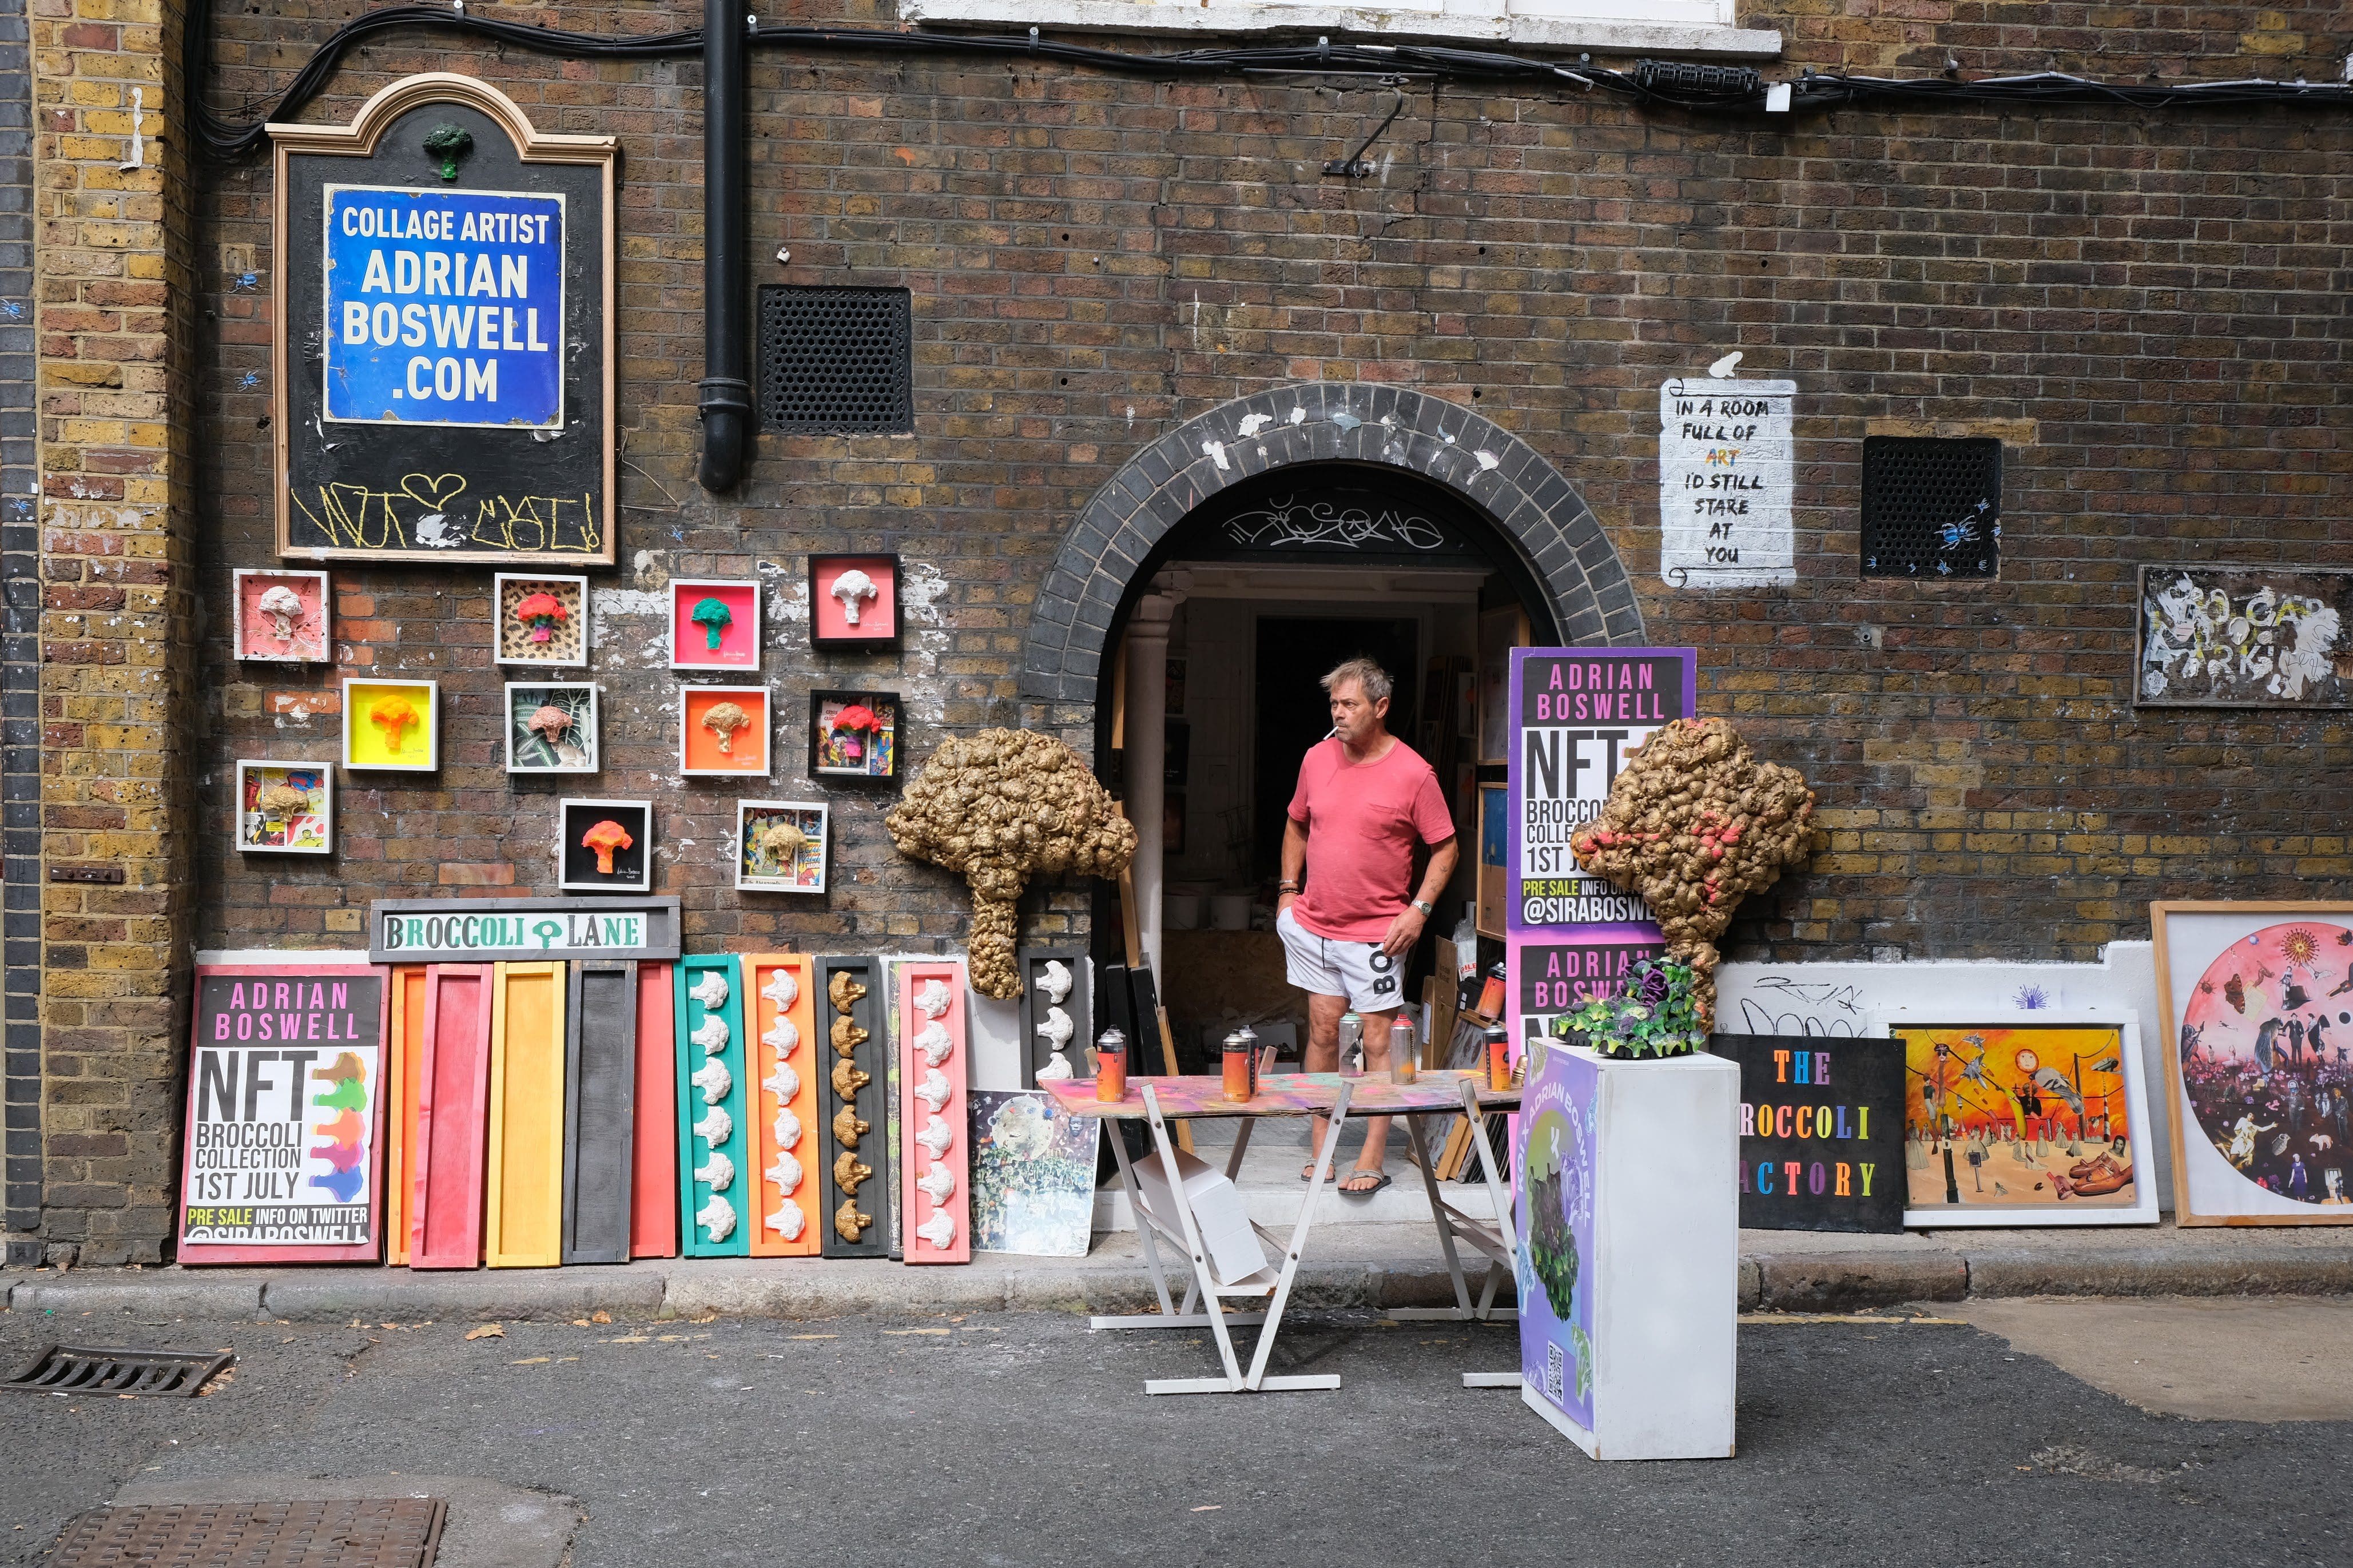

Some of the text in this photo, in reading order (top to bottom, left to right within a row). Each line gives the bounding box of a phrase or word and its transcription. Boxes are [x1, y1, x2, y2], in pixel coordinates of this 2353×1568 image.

[343, 206, 549, 244] COLLAGE ARTIST
[361, 249, 528, 299] ADRIAN
[343, 301, 549, 352] BOSWELL
[392, 356, 498, 402] .COM
[1676, 400, 1769, 418] IN A ROOM
[1682, 423, 1758, 441] FULL OF
[1705, 448, 1740, 467] ART
[1685, 472, 1764, 491] I'D STILL
[1694, 498, 1750, 516] STARE
[1709, 522, 1734, 540] AT
[1705, 547, 1739, 563] YOU
[1549, 663, 1652, 690] ADRIAN
[1537, 693, 1664, 720] BOSWELL
[1526, 730, 1629, 799] NFT
[1526, 799, 1606, 824] BROCCO
[1527, 824, 1573, 843] COLLE
[1527, 846, 1563, 872] 1ST
[1523, 880, 1546, 896] PRE
[1549, 880, 1579, 896] SALE
[1581, 880, 1607, 896] INFO
[385, 914, 639, 950] BROCCOLI LANE
[1367, 942, 1396, 994] BO
[230, 982, 347, 1009] ADRIAN
[214, 1013, 359, 1040] BOSWELL
[1774, 1050, 1830, 1085] THE
[197, 1050, 318, 1122] NFT
[1739, 1103, 1869, 1140] ROCCOLI
[196, 1123, 303, 1148] BROCCOLI
[195, 1148, 301, 1169] COLLECTION
[1517, 1143, 1525, 1193] KOI
[1521, 1119, 1529, 1143] X
[1529, 1082, 1565, 1125] ADRIAN
[1565, 1092, 1591, 1227] BOSWELL
[194, 1172, 300, 1200] 1ST JULY
[1739, 1160, 1875, 1196] ACTORY
[187, 1207, 368, 1225] PRE SALE INFO ON TWITTER
